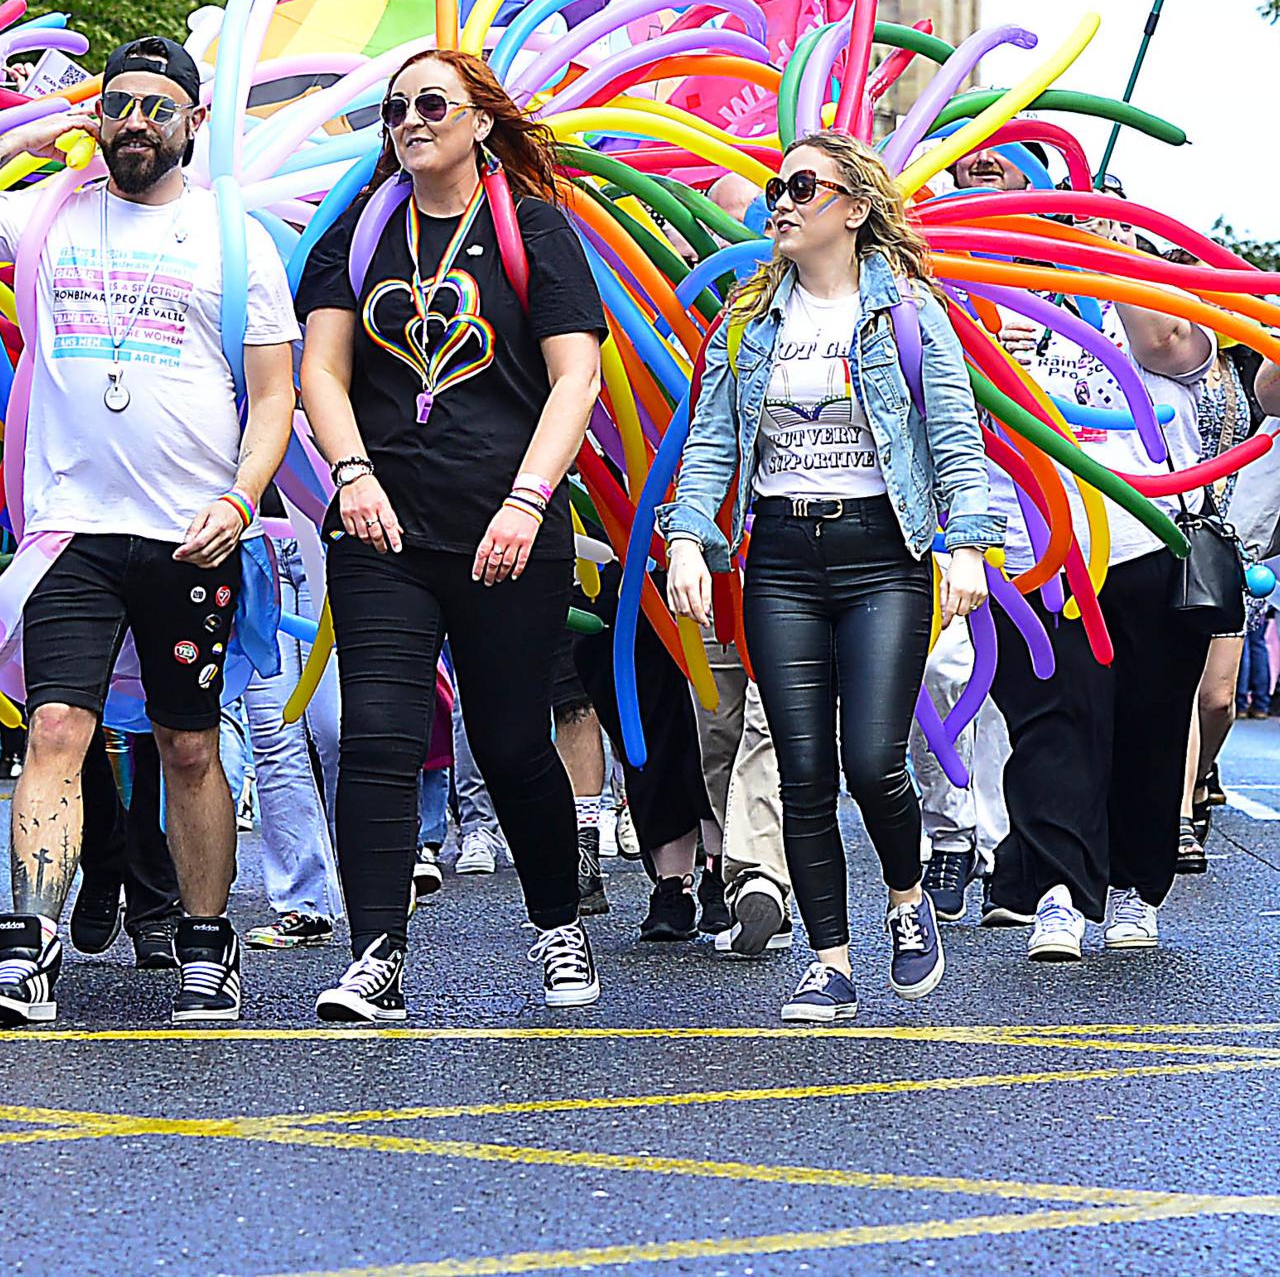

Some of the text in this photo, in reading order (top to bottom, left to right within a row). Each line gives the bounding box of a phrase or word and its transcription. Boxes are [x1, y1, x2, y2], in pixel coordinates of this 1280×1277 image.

[806, 425, 863, 446] VERY
[0, 921, 26, 930] adidas
[193, 924, 220, 932] adidas
